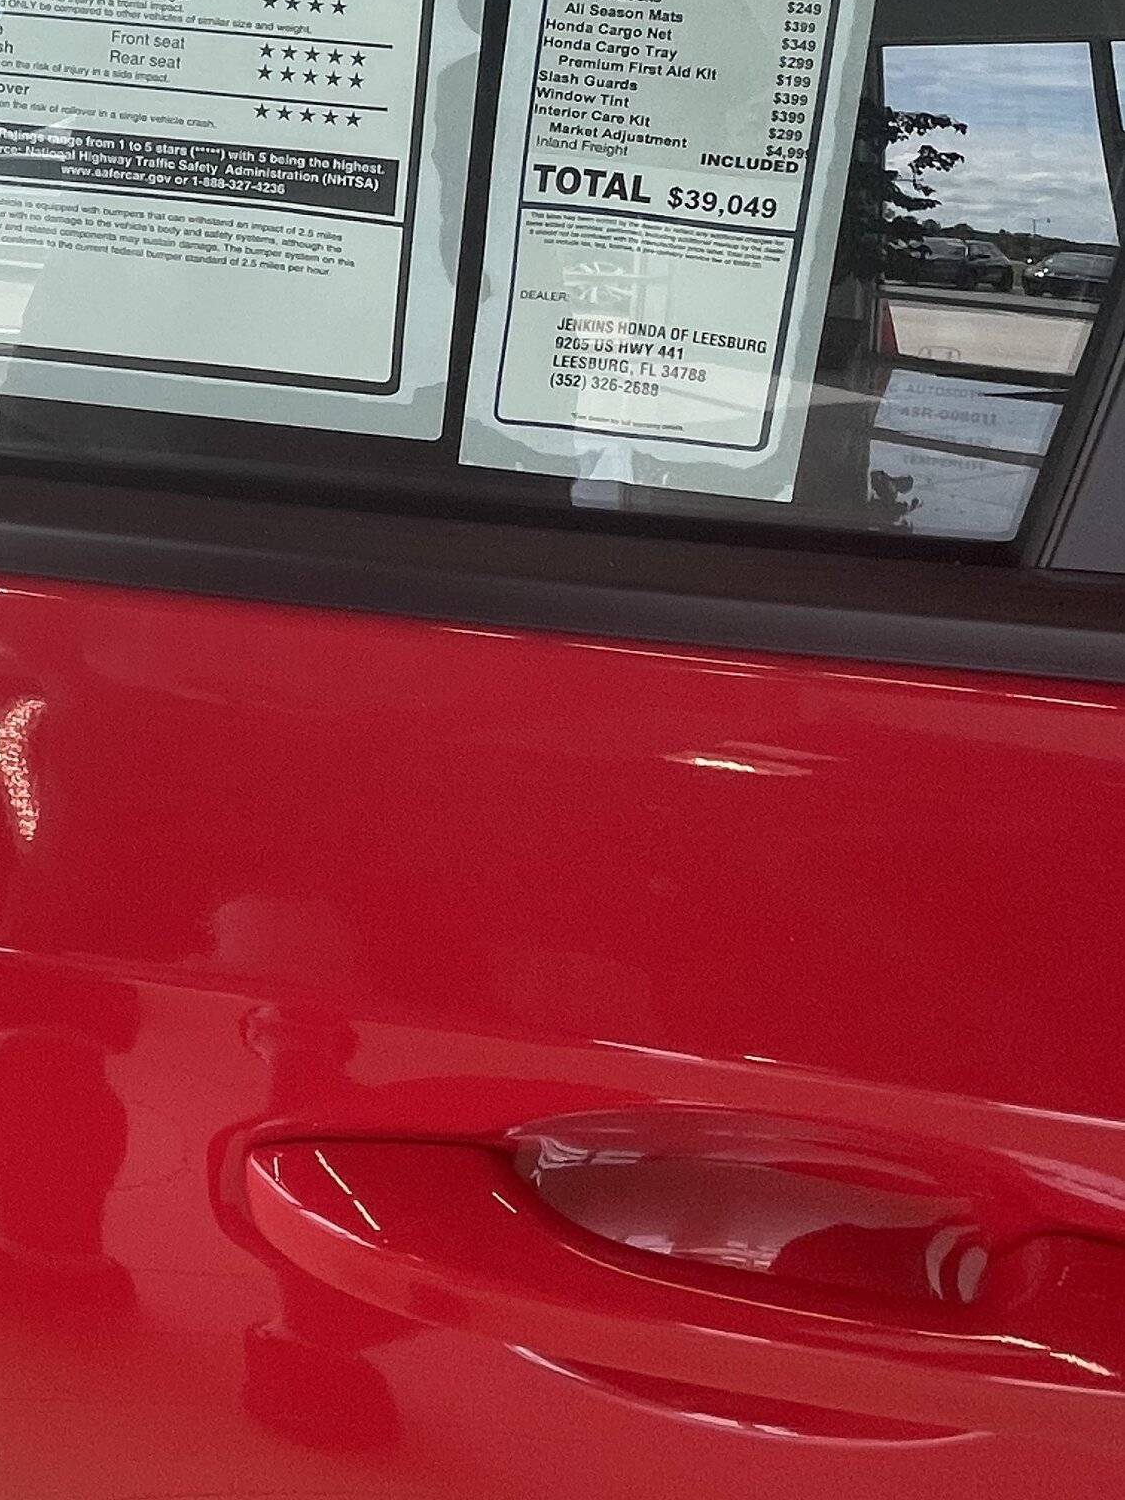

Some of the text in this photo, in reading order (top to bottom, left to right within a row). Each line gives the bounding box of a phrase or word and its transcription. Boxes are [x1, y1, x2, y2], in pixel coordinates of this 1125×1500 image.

[787, 1, 822, 15] $249
[111, 30, 148, 48] Front
[152, 33, 184, 50] seat
[545, 19, 672, 41] Honda Cargo Net
[781, 38, 816, 52] $349
[109, 51, 145, 67] Rear
[148, 52, 181, 69] seat
[701, 153, 799, 174] INCLUDED
[533, 163, 777, 220] TOTAL $39,049
[557, 318, 767, 354] JENKINS HONDA OF LEESBURG
[553, 354, 707, 383] LEESBURG, FL 34788
[550, 373, 659, 397] (352) 326-2688
